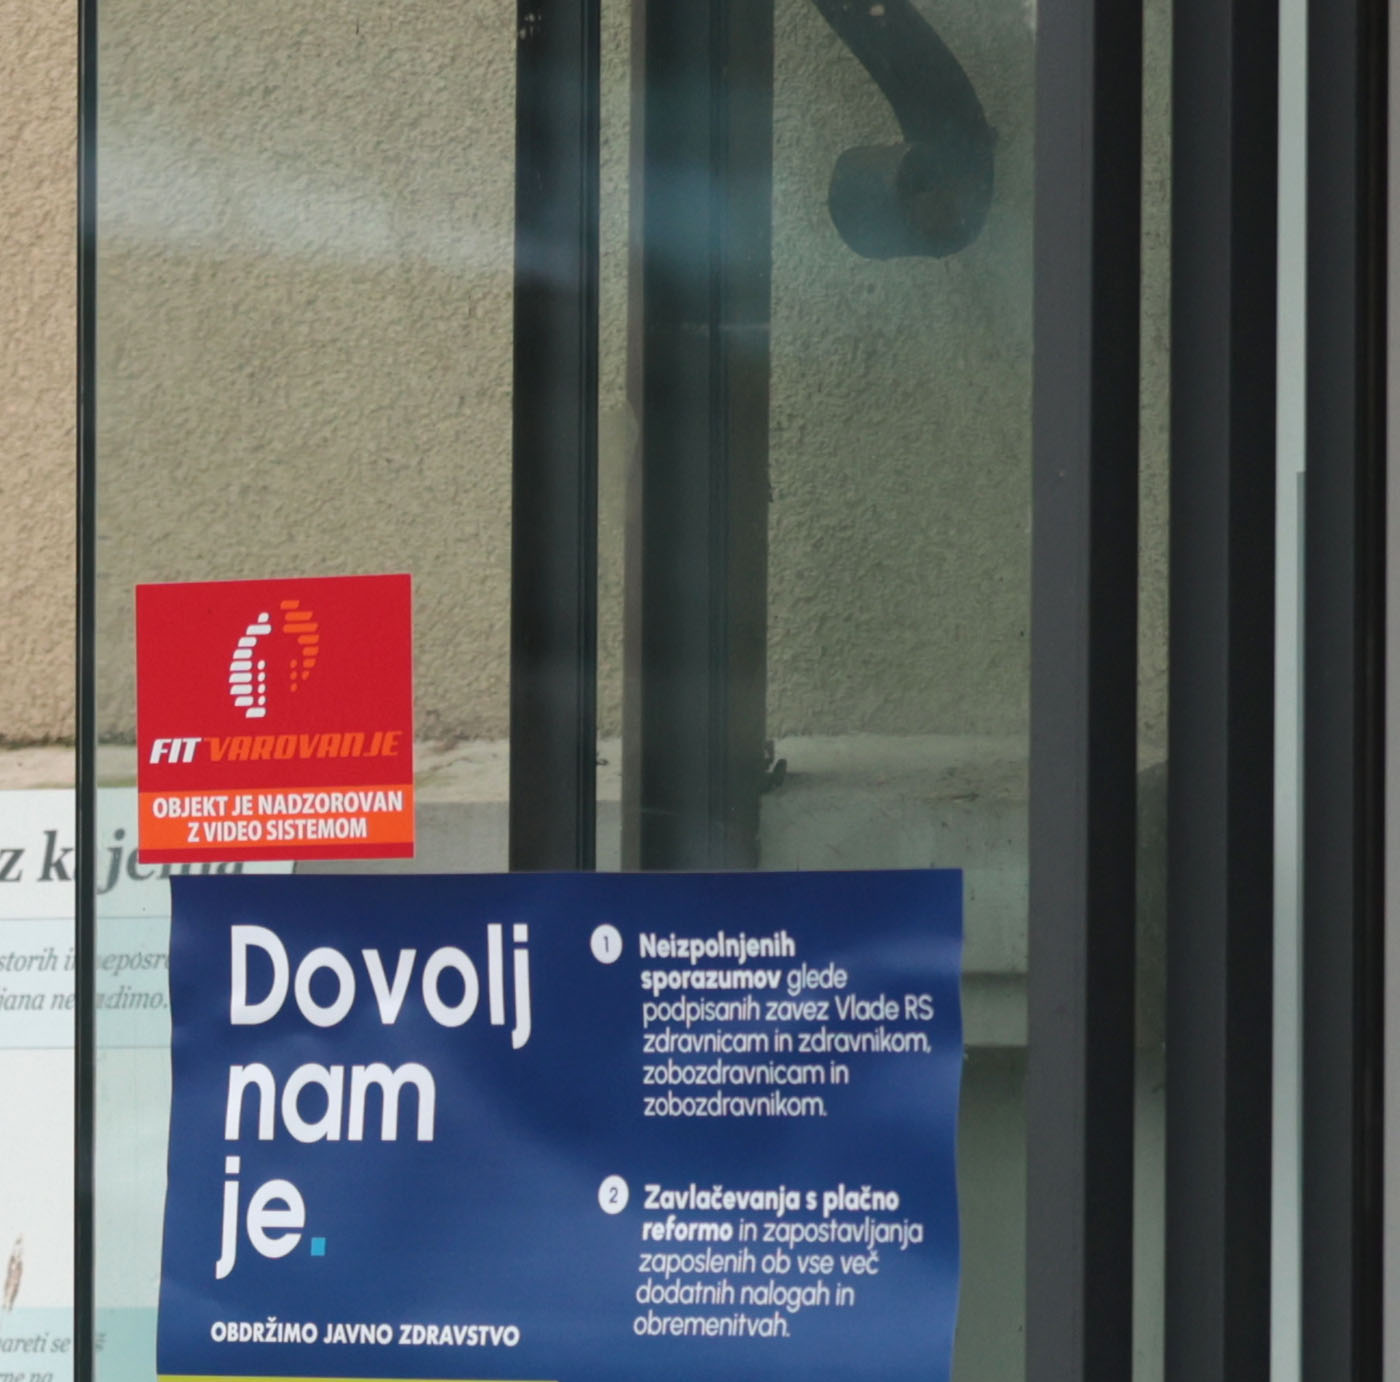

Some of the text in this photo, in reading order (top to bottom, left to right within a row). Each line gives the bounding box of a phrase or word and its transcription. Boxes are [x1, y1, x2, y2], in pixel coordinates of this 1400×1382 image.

[149, 737, 202, 764] FIT
[153, 791, 403, 818] OBJEKT JE NADZOROVAN
[187, 818, 367, 842] Z VIDEO SISTEMOM
[639, 930, 795, 965] Neizpolnjenih
[231, 923, 531, 1049] Dovolj
[640, 962, 847, 997] sporazumov glede
[50, 993, 75, 1010] ne
[643, 995, 934, 1029] podpisanih zavez Vlade RS
[643, 1026, 932, 1054] zdravnicam in zdravnikom,
[643, 1058, 849, 1085] zobozdravnicam in
[225, 1062, 435, 1142] nam
[643, 1089, 827, 1117] zobozdravnikom.
[610, 1186, 618, 1203] 2
[643, 1183, 899, 1218] Zavlačevanja s plačno
[216, 1157, 326, 1279] je.
[642, 1215, 923, 1250] reformo in zapostavljanja
[638, 1247, 879, 1280] zaposlenih ob vse več
[636, 1278, 855, 1313] dodatnih nalogah in
[211, 1317, 520, 1346] OBDRŽIMO JAVNO ZDRAVSTVO
[633, 1310, 791, 1337] obremenitvah.
[50, 1336, 71, 1353] se
